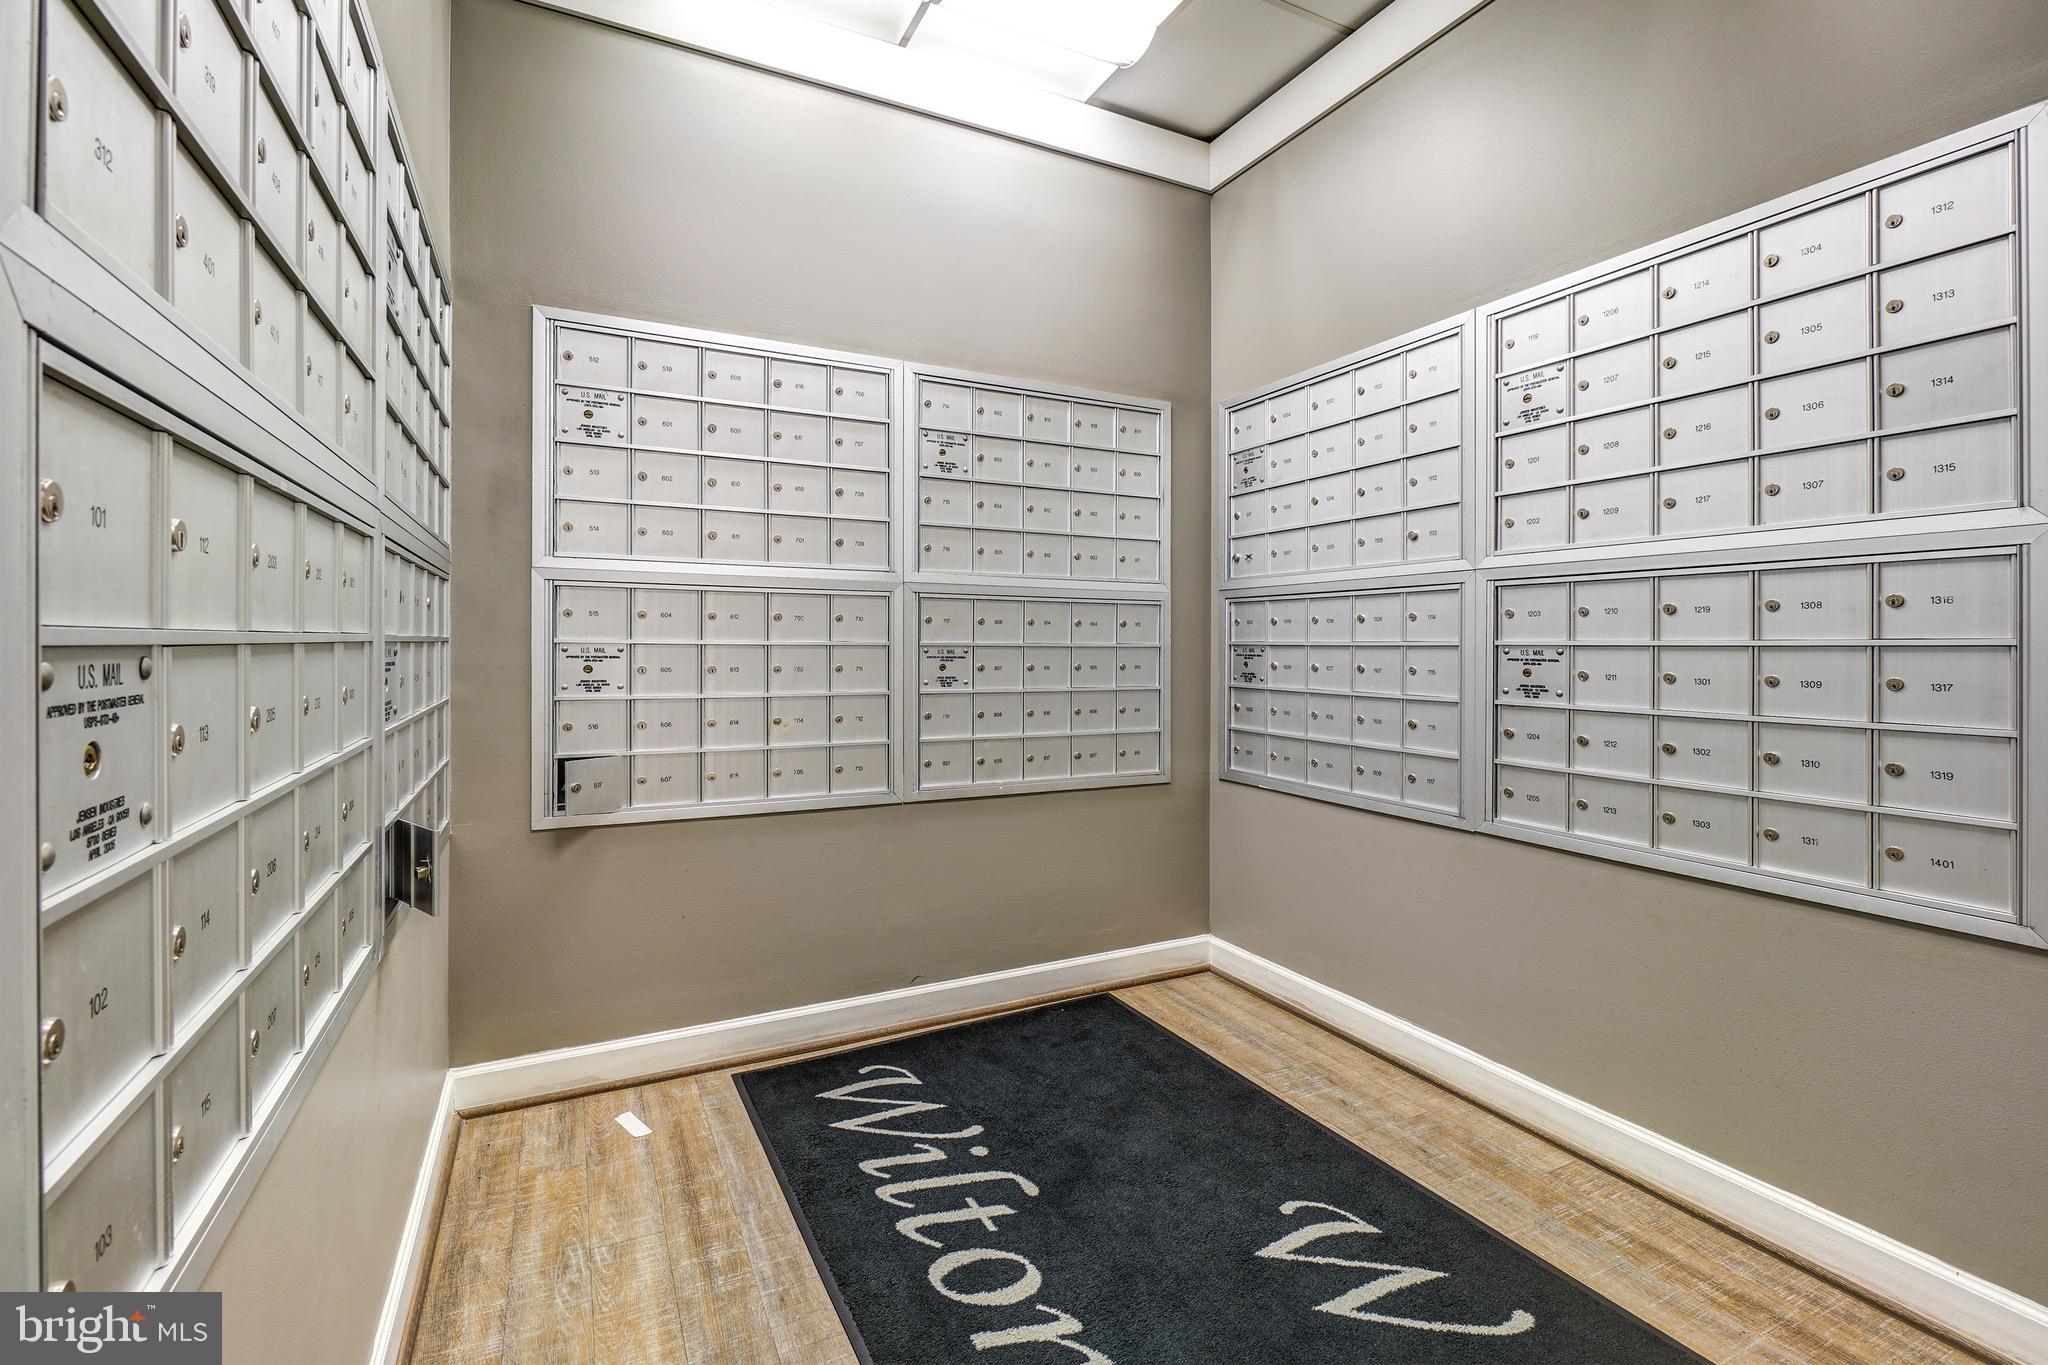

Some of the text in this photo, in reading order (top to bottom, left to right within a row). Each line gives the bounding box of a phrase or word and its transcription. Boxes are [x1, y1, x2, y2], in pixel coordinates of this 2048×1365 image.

[94, 137, 112, 172] 312
[1932, 201, 1954, 214] 1312
[1801, 244, 1821, 256] 1304
[203, 254, 215, 277] 401
[1694, 280, 1709, 289] 1214
[1932, 289, 1955, 302] 1313
[1801, 323, 1822, 335] 1305
[1695, 350, 1711, 360] 1215
[1604, 374, 1618, 383] 1207
[1931, 376, 1954, 387] 1314
[1802, 401, 1824, 411] 1306
[1696, 423, 1711, 432] 1216
[1604, 441, 1619, 449] 1208
[1933, 463, 1956, 473] 1315
[1803, 480, 1824, 489] 1307
[1696, 495, 1711, 503] 1217
[1603, 507, 1619, 515] 1209
[91, 505, 106, 528] 101
[200, 537, 209, 554] 112
[1801, 601, 1822, 609] 1308
[1931, 596, 1954, 604] 1316
[78, 663, 124, 689] U.S. MAIL
[1931, 683, 1953, 692] 1317
[199, 725, 209, 742] 113
[1693, 748, 1711, 756] 1302
[1801, 760, 1820, 768] 1310
[1930, 771, 1953, 781] 1319
[1693, 820, 1710, 829] 1303
[1802, 837, 1818, 846] 1311
[1930, 858, 1954, 869] 1401
[200, 909, 210, 930] 114
[89, 987, 108, 1018] 102
[201, 1093, 211, 1117] 115
[94, 1224, 112, 1262] 103
[1257, 1200, 1535, 1335] W
